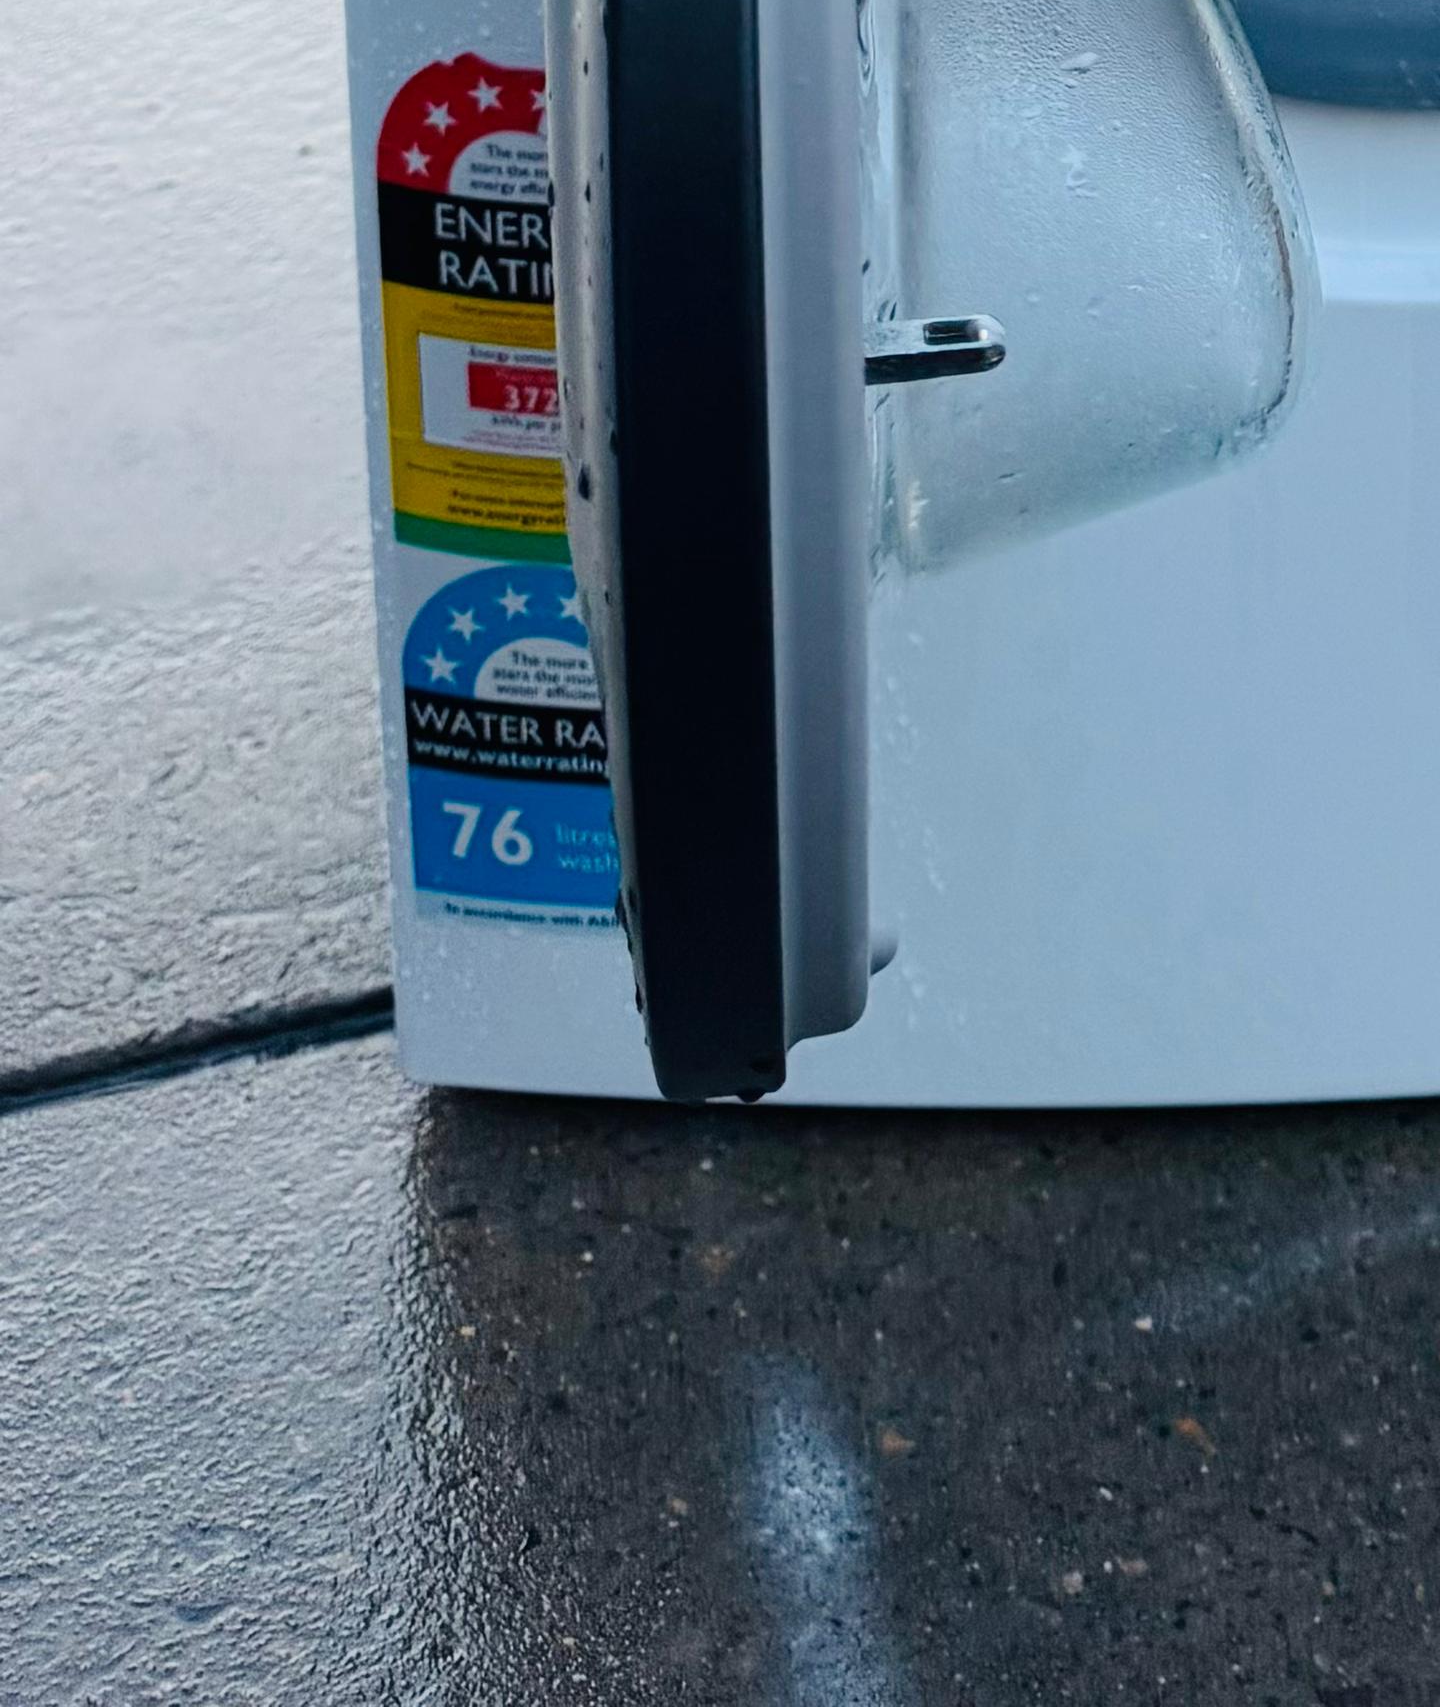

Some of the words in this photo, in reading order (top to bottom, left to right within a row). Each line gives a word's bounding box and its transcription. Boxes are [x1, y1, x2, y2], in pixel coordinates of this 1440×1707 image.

[434, 202, 549, 250] ENER
[439, 249, 552, 298] RATI
[411, 699, 543, 746] WATER
[415, 738, 607, 777] www.waterratin
[442, 801, 533, 866] 76
